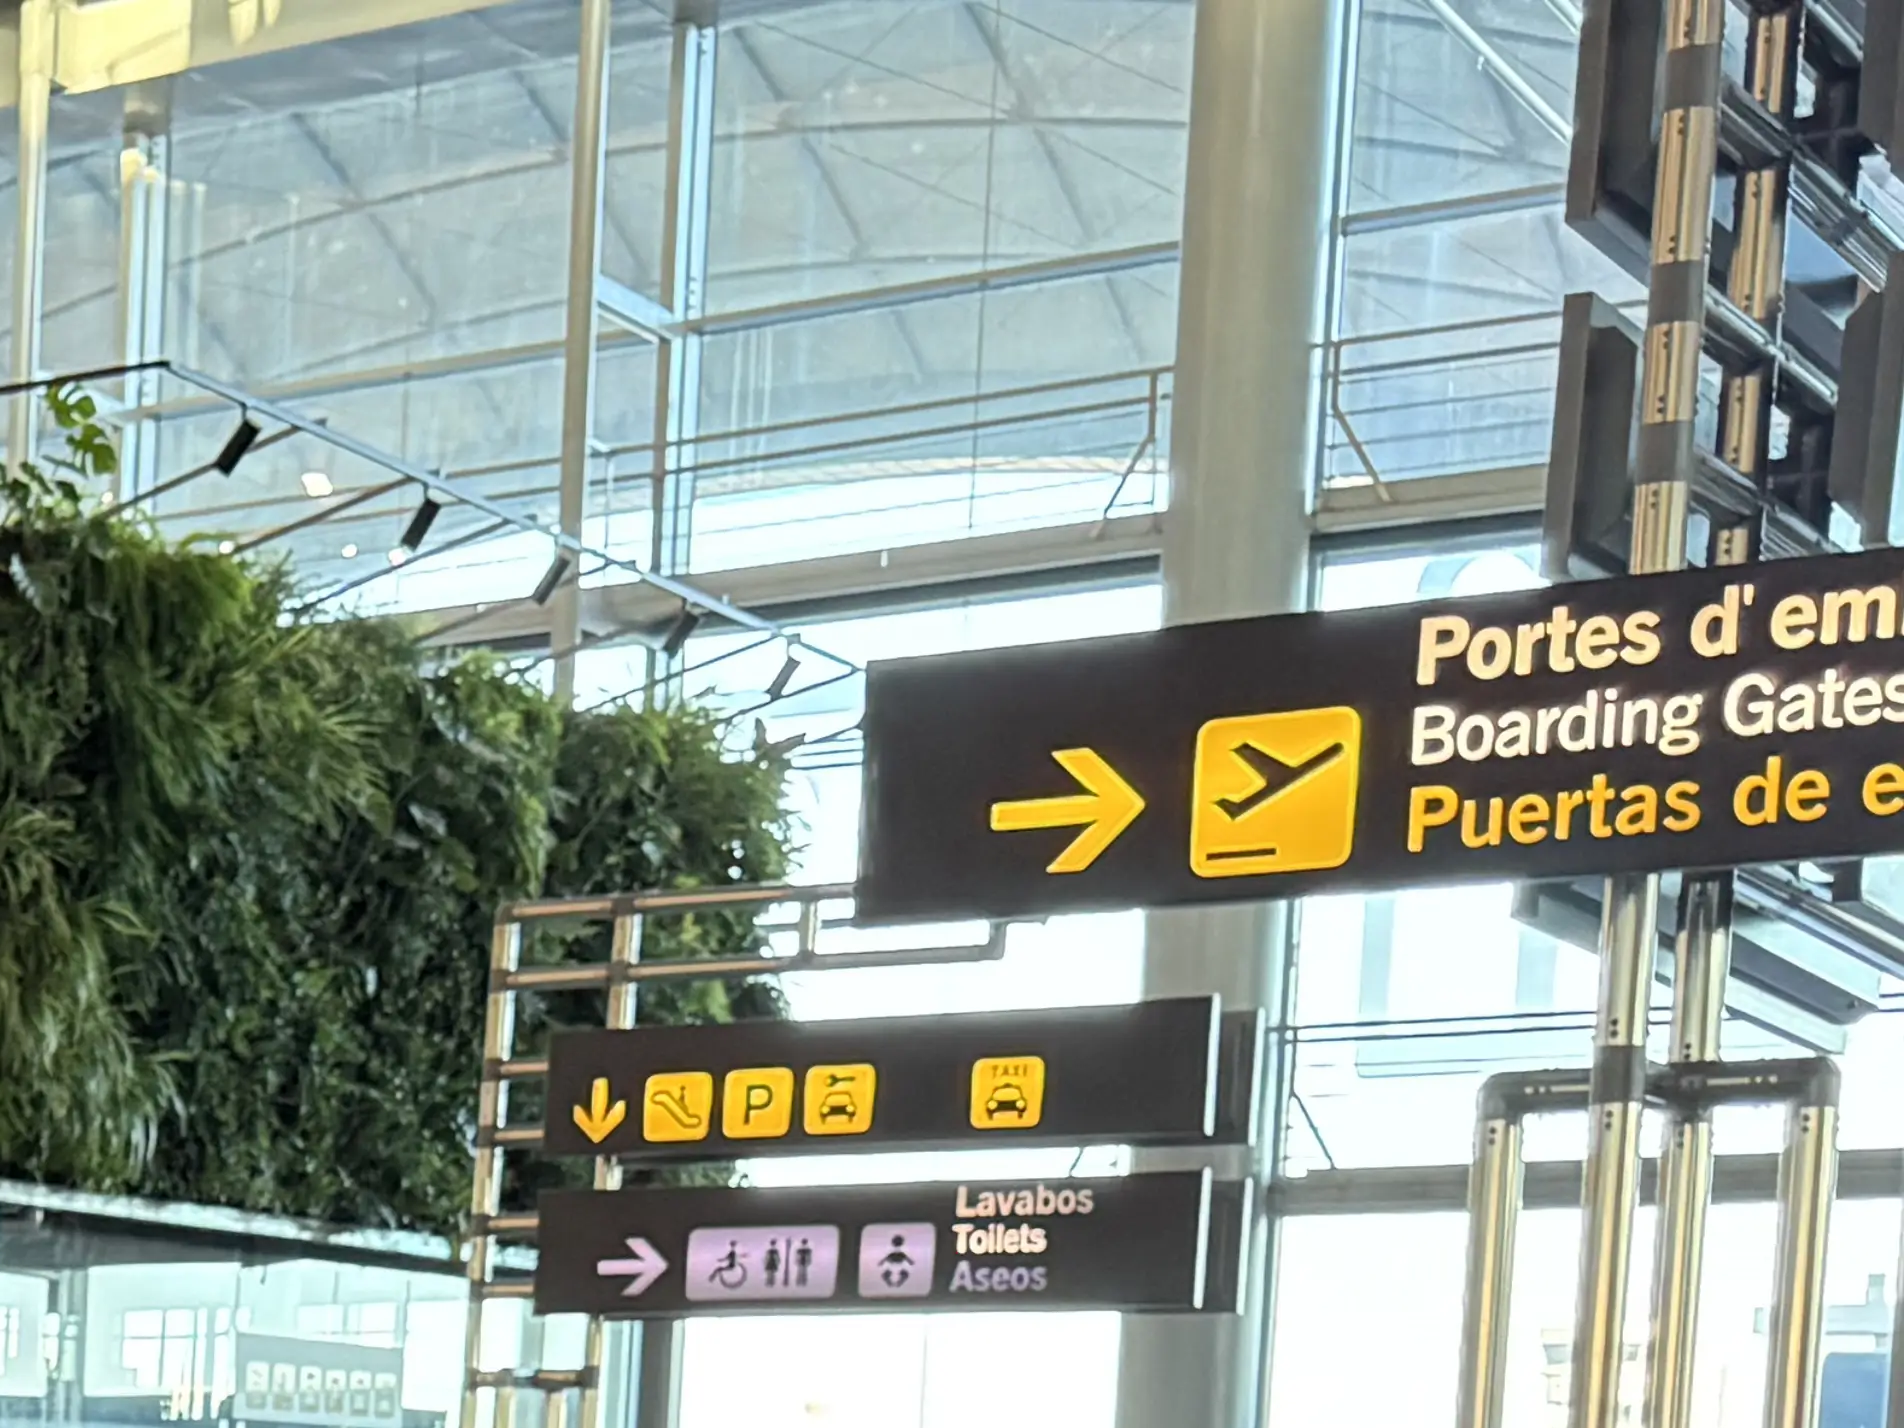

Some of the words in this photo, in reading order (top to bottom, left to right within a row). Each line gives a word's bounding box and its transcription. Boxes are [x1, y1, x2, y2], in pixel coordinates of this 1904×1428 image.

[1416, 606, 1661, 685] Portes
[1770, 584, 1904, 650] em
[1410, 687, 1704, 766] Boarding
[1723, 669, 1904, 737] Gates
[1407, 773, 1701, 852] Puertas
[1733, 755, 1830, 826] de
[955, 1185, 1095, 1219] Lavabos
[952, 1222, 1049, 1255] Toilets
[948, 1260, 1049, 1293] Aseos
